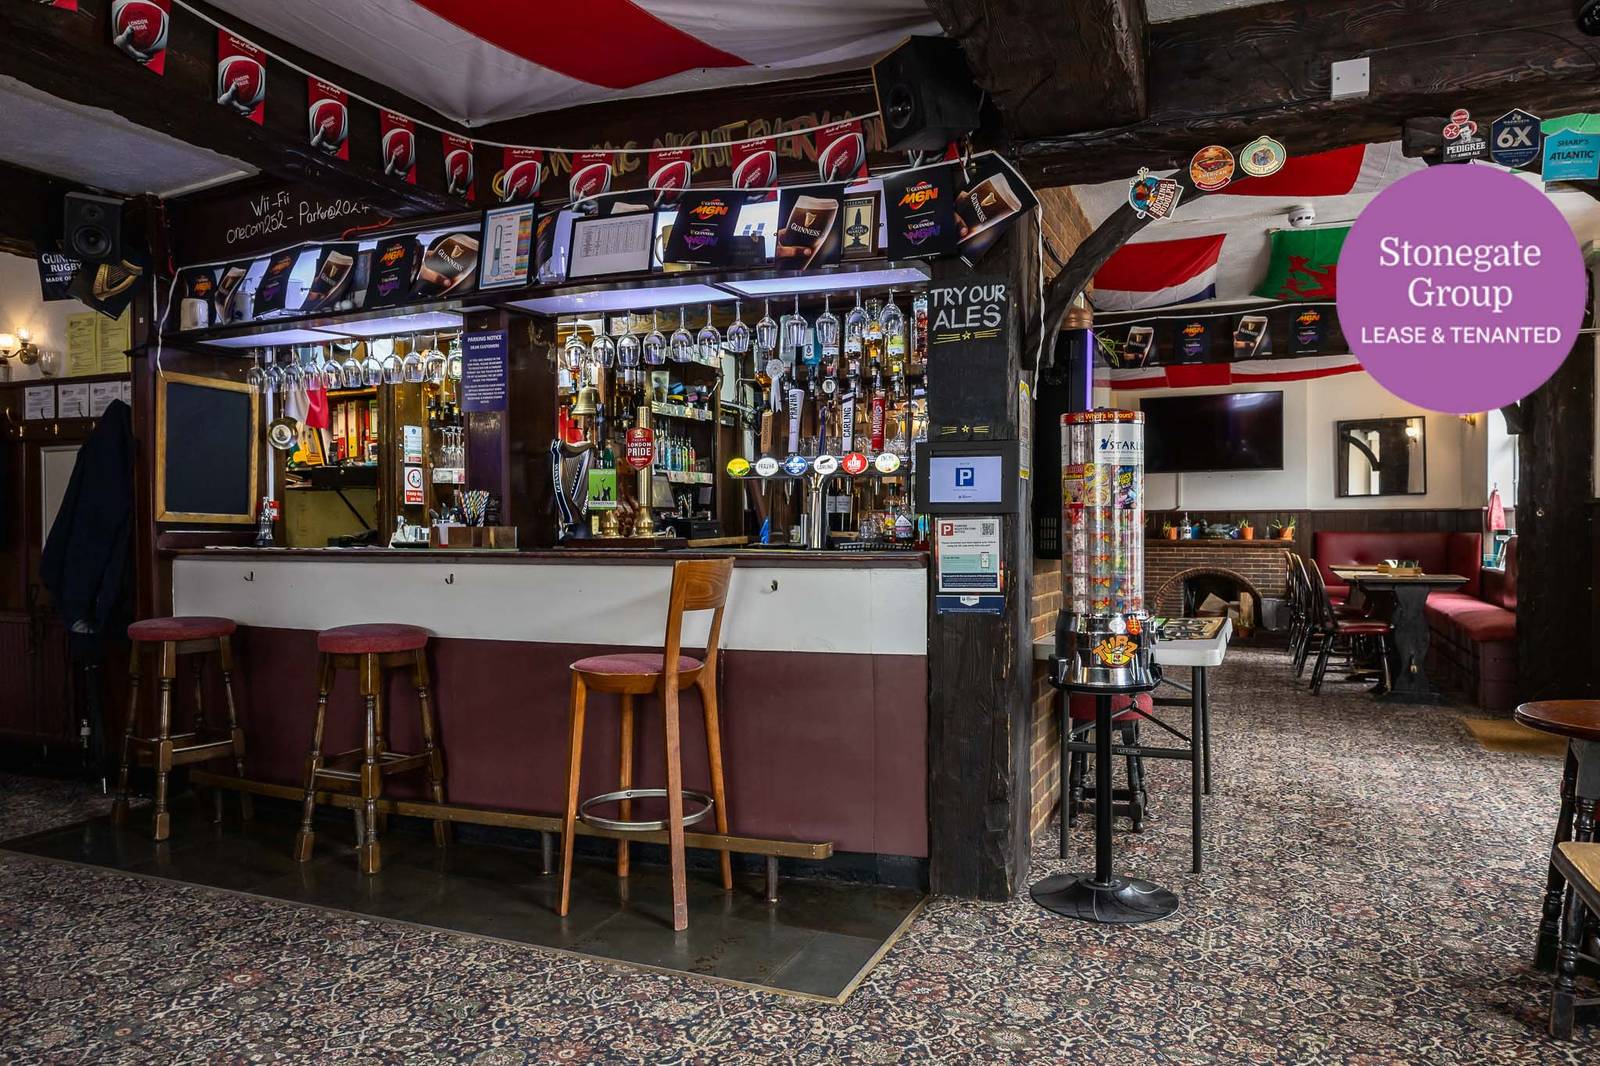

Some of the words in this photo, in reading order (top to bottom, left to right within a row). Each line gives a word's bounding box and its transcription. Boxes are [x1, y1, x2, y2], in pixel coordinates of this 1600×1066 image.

[1497, 125, 1533, 148] 6X
[1446, 142, 1486, 155] PEDIGREE
[1550, 150, 1595, 161] ATLANTIC
[971, 192, 987, 223] GUINNESS
[1151, 183, 1168, 214] ROCKING
[1157, 182, 1176, 217] RUDOLPH
[791, 222, 821, 238] GUINNESS
[51, 262, 82, 273] RUGBY
[438, 249, 464, 271] GUINNESS
[930, 286, 967, 307] TRY
[969, 284, 1006, 303] OUR
[932, 304, 1001, 331] ALES
[843, 406, 852, 438] CARLING
[628, 447, 652, 456] PRIDE
[959, 469, 972, 486] P
[943, 525, 951, 535] P
[1093, 635, 1138, 660] TUBZ
